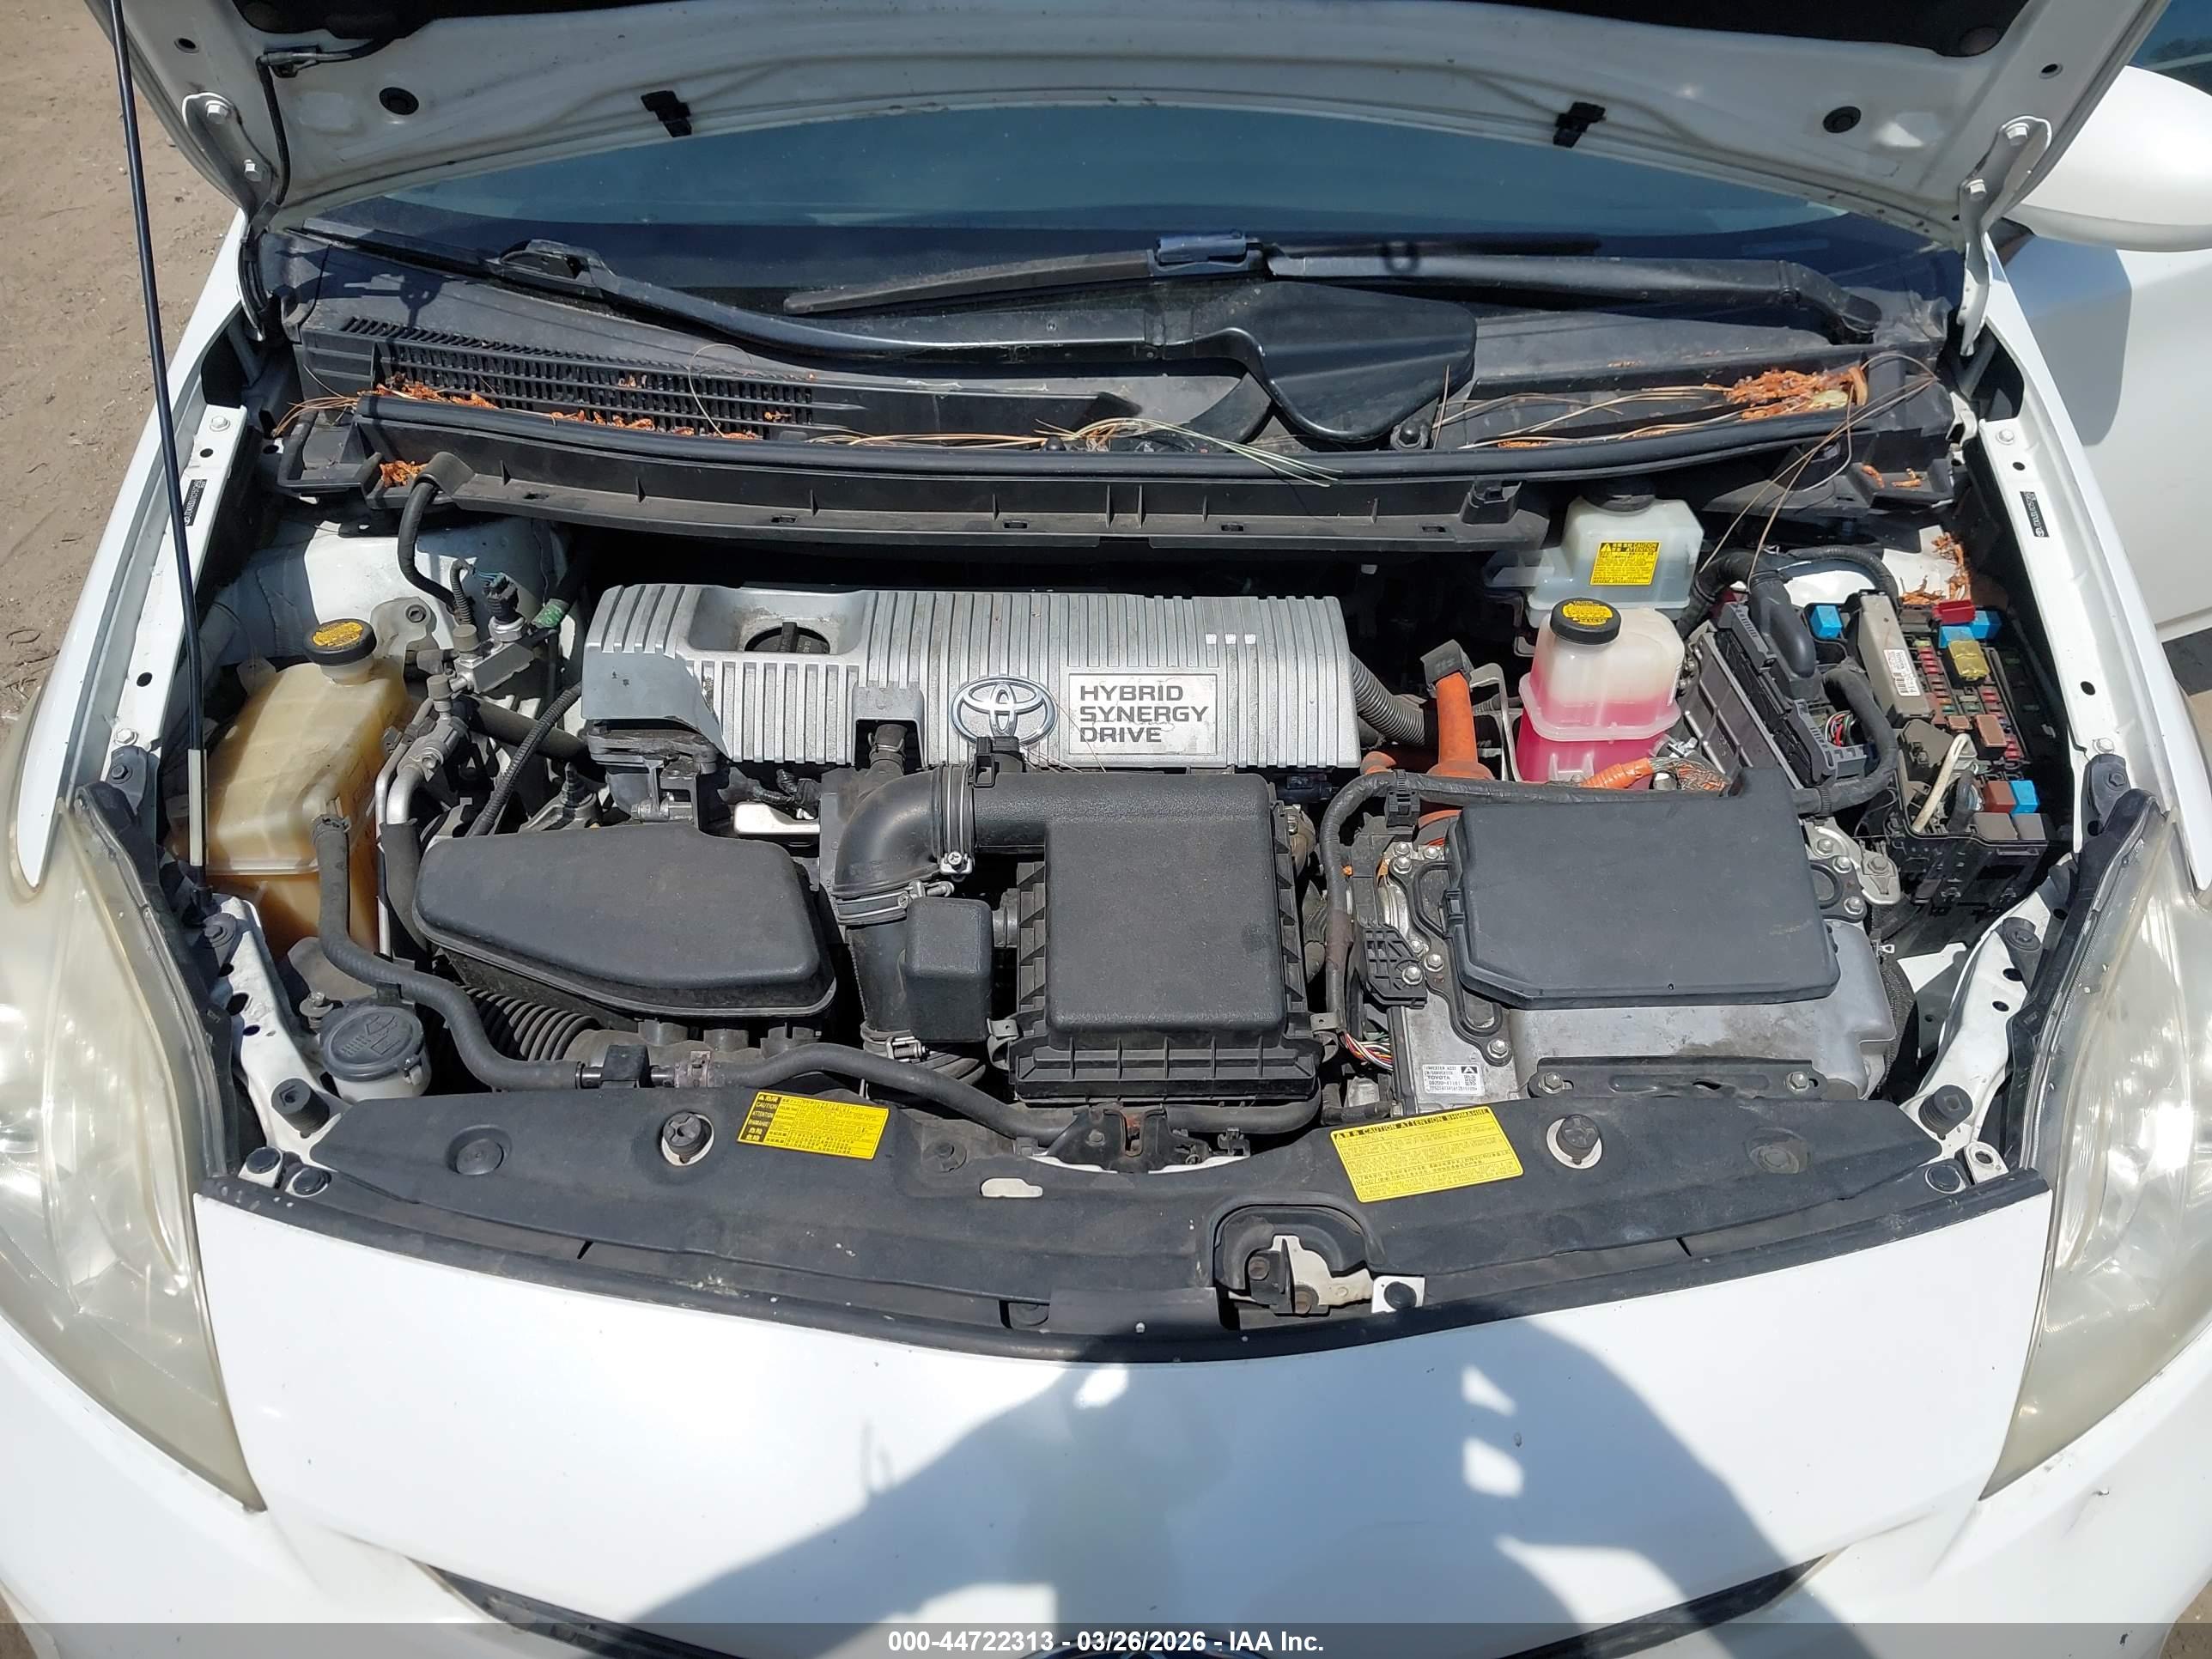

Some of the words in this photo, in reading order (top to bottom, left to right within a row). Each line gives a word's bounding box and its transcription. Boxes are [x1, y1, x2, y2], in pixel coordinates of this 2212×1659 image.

[1080, 685, 1183, 701] HYBRID
[1080, 706, 1209, 722] SYNERGY
[1080, 727, 1162, 743] DRIVE
[756, 1102, 778, 1110] CAUTION
[1364, 1124, 1396, 1134] CAUTION
[1401, 1116, 1443, 1129] ATTENTION
